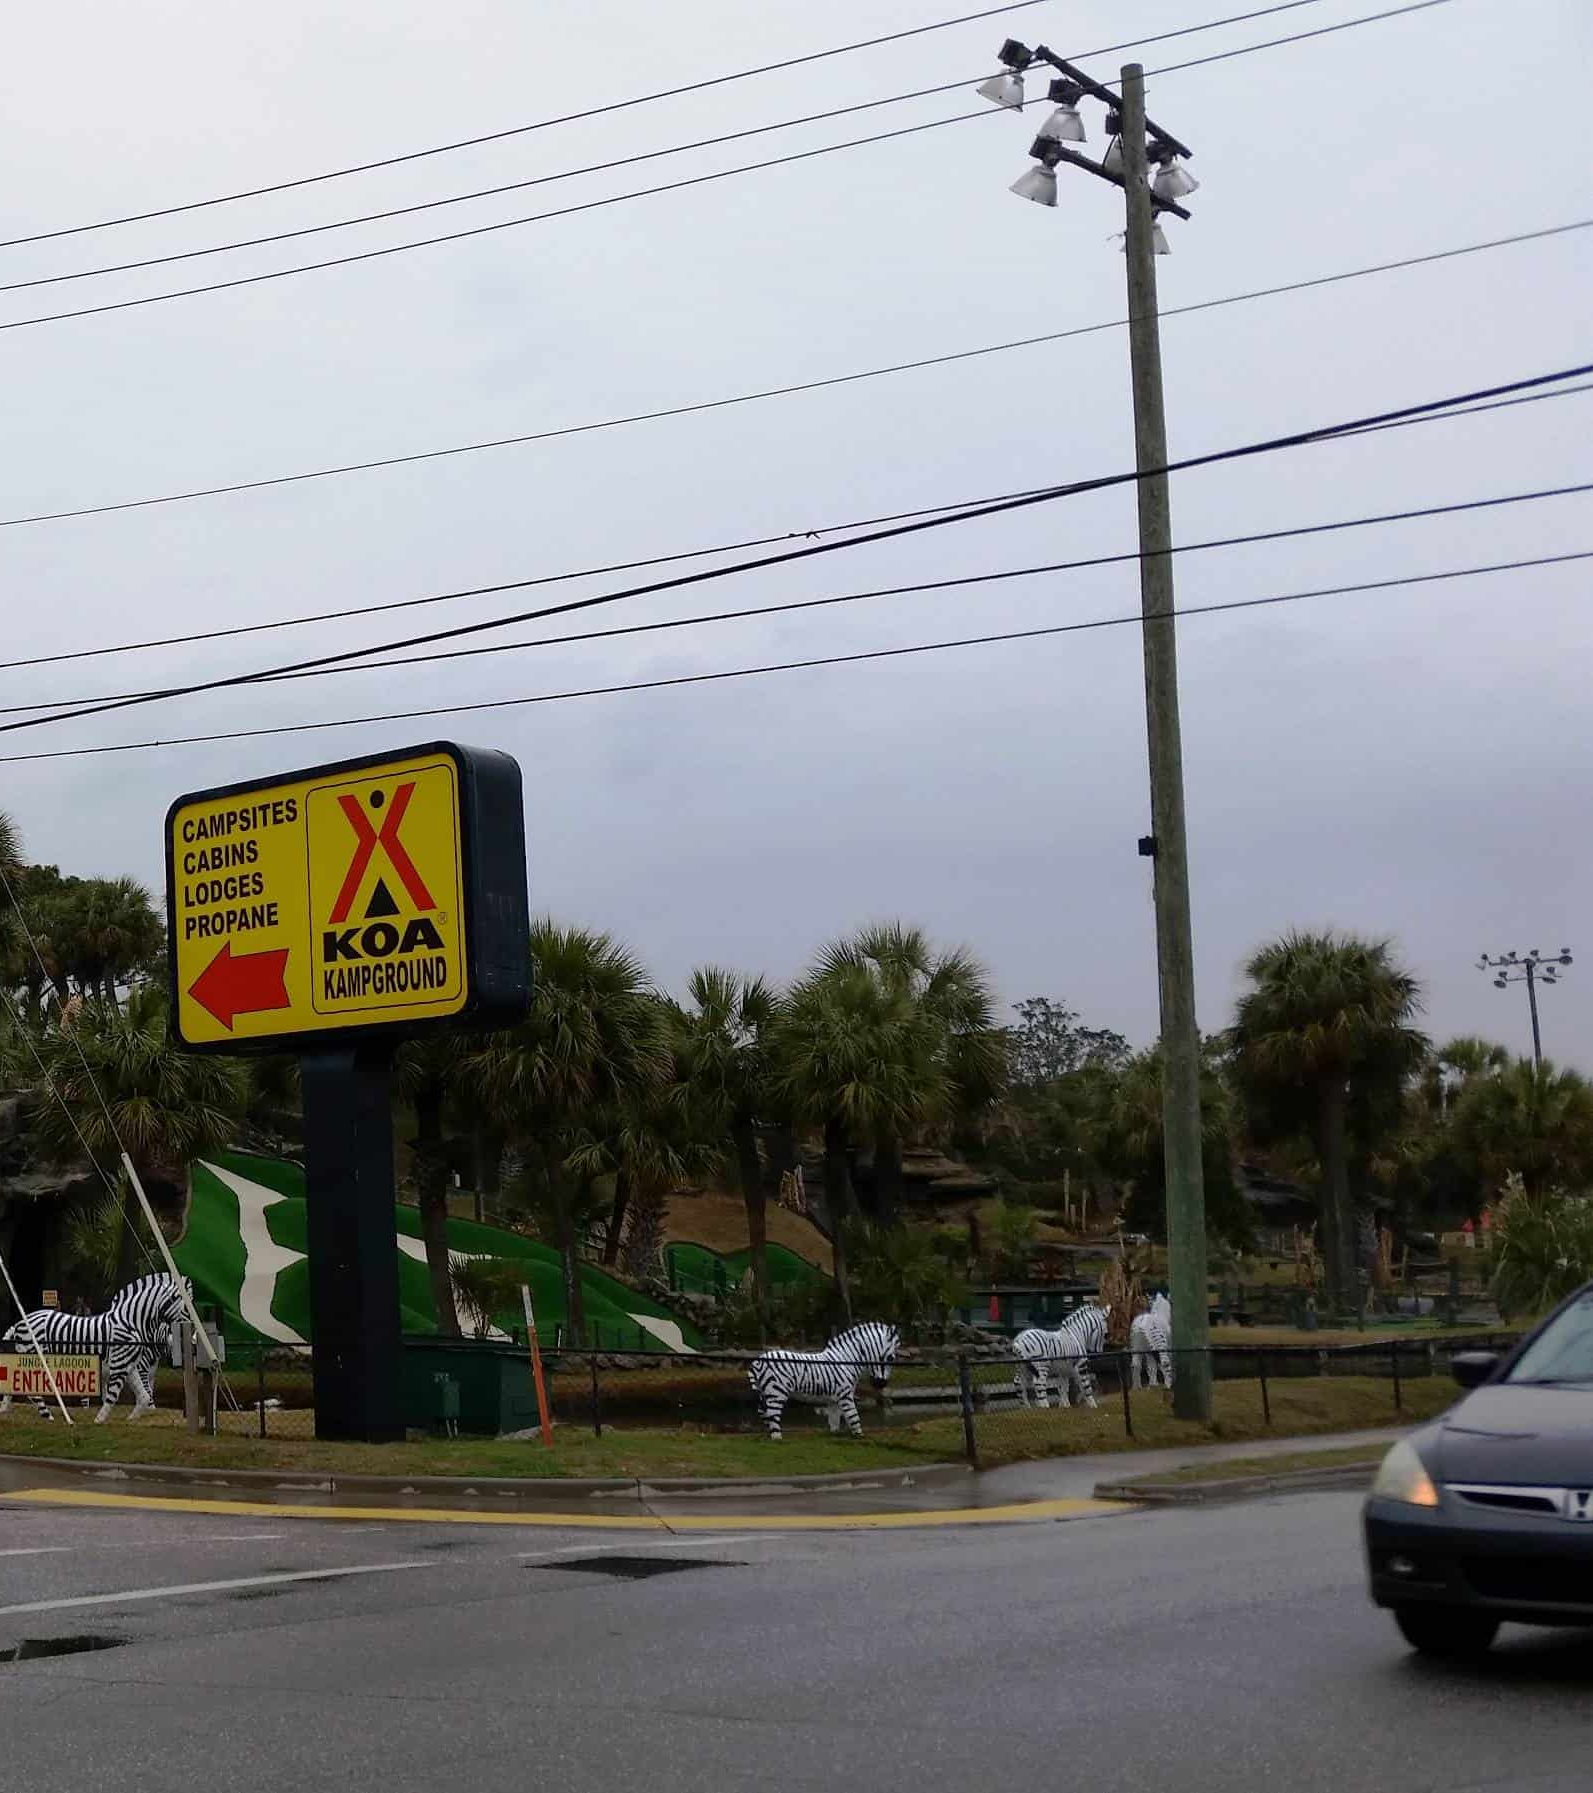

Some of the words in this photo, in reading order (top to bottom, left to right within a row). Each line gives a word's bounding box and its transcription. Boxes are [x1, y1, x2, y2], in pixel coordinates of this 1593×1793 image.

[182, 798, 298, 843] CAMPSITES
[183, 840, 259, 875] CABINS
[184, 872, 264, 908] LODGES
[185, 903, 279, 940] PROPANE
[323, 918, 445, 963] KOA
[324, 956, 447, 1000] KAMPGROUND
[54, 1357, 91, 1369] LAGOON
[13, 1370, 96, 1393] ENTRANCE
